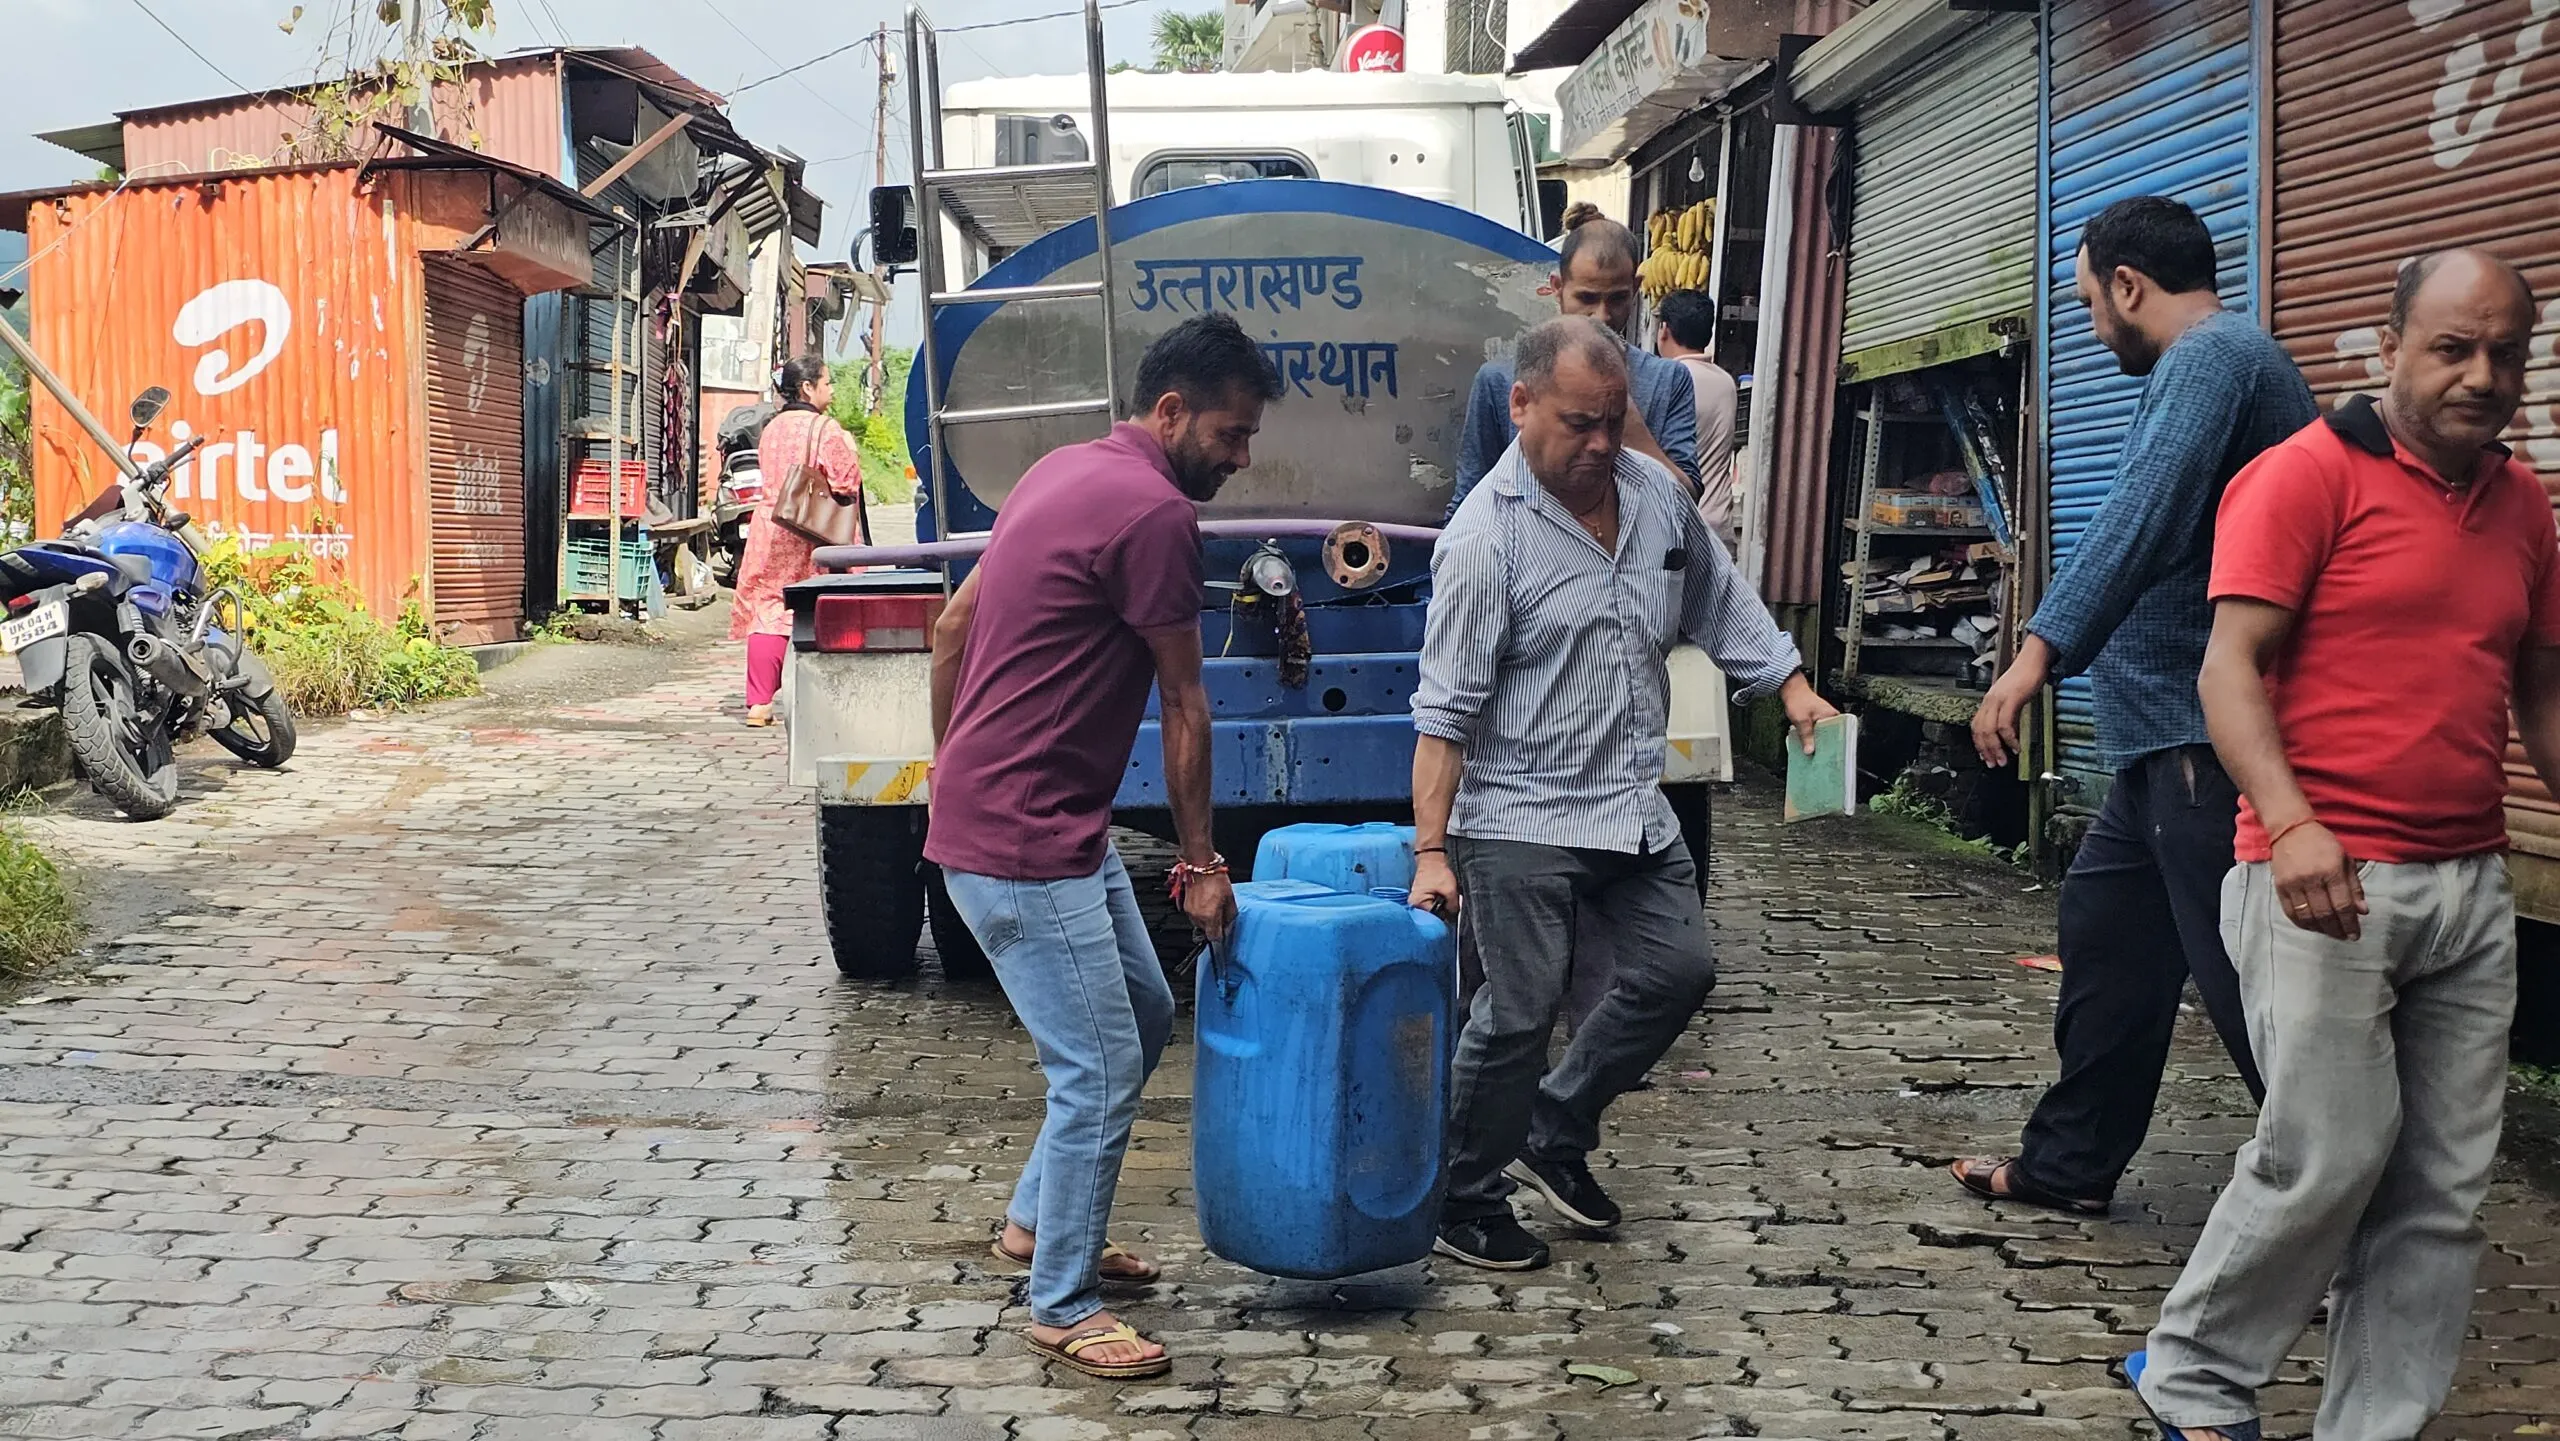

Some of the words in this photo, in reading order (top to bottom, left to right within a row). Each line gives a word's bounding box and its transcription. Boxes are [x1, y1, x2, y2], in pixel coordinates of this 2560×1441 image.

[1128, 256, 1364, 313] उत्तराखण्ड
[116, 420, 348, 504] airtel
[9, 622, 25, 635] UK
[27, 614, 42, 628] 04
[44, 610, 53, 621] H
[11, 620, 58, 646] 7584
